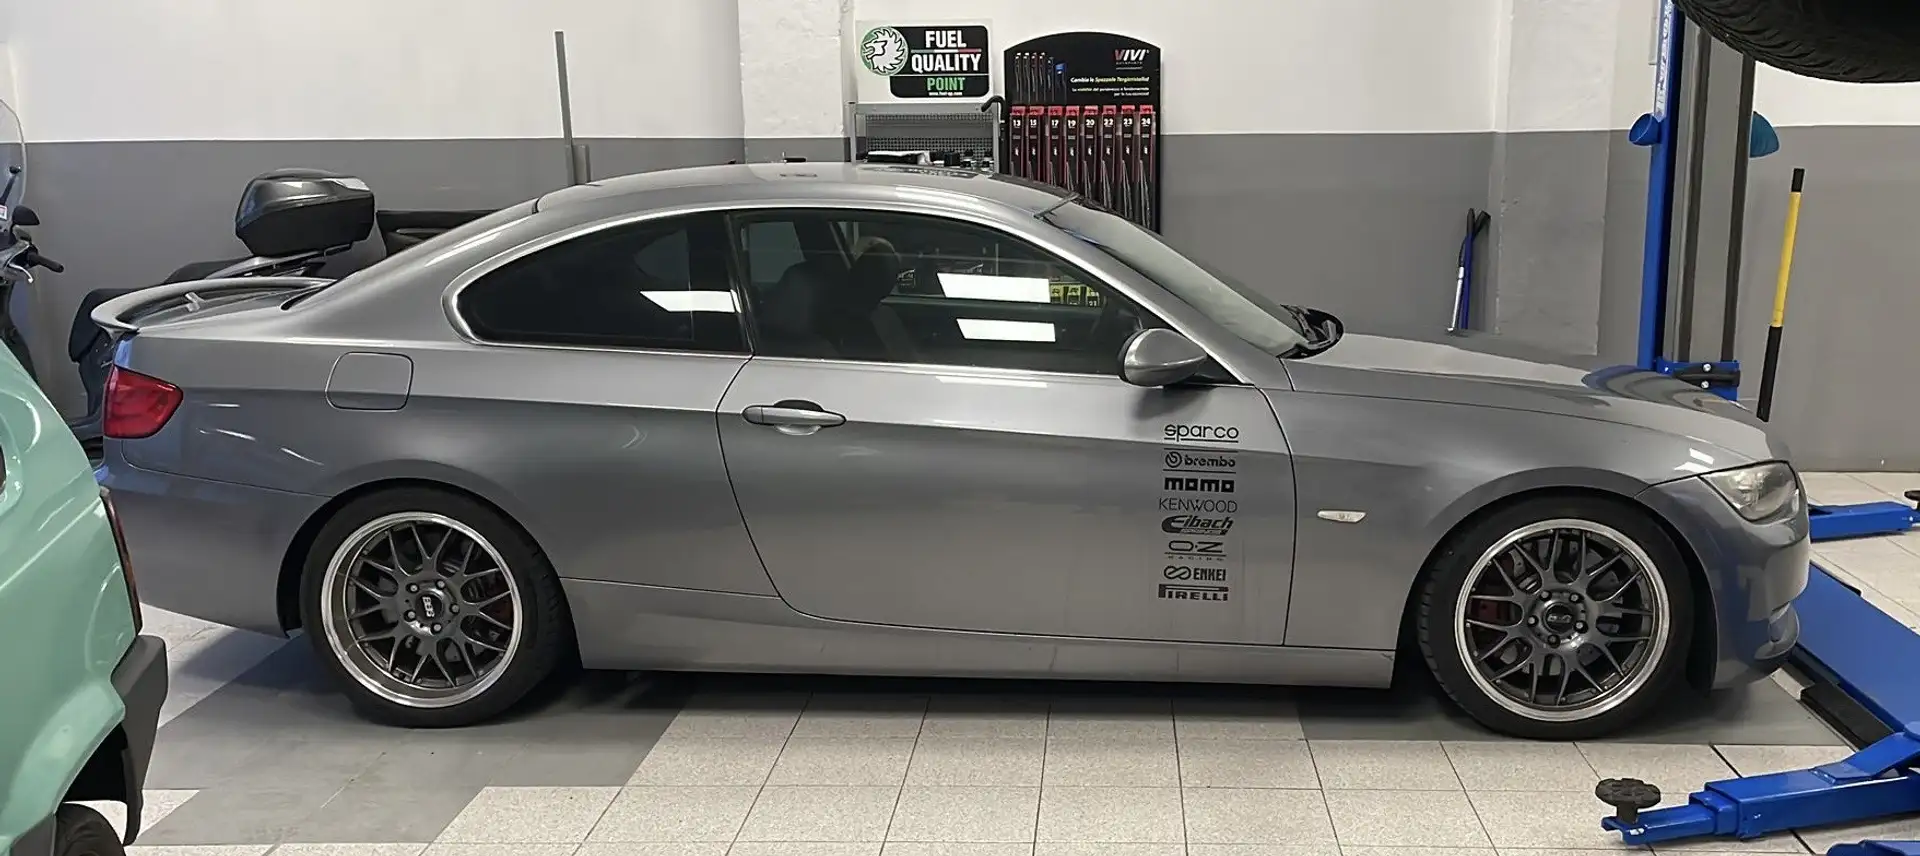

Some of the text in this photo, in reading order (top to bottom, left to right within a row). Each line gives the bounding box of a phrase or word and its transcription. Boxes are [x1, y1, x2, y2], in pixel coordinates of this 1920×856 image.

[925, 30, 967, 48] FUEL
[911, 54, 981, 73] QUALITY
[1114, 49, 1146, 61] VIVI
[927, 77, 965, 91] POINT
[1164, 424, 1239, 443] sparco
[1184, 455, 1236, 467] brembo
[1159, 497, 1238, 514] KENWOOD
[1161, 515, 1234, 536] Eibach
[1193, 567, 1226, 581] ENKEI
[1158, 584, 1229, 602] PIRELLI
